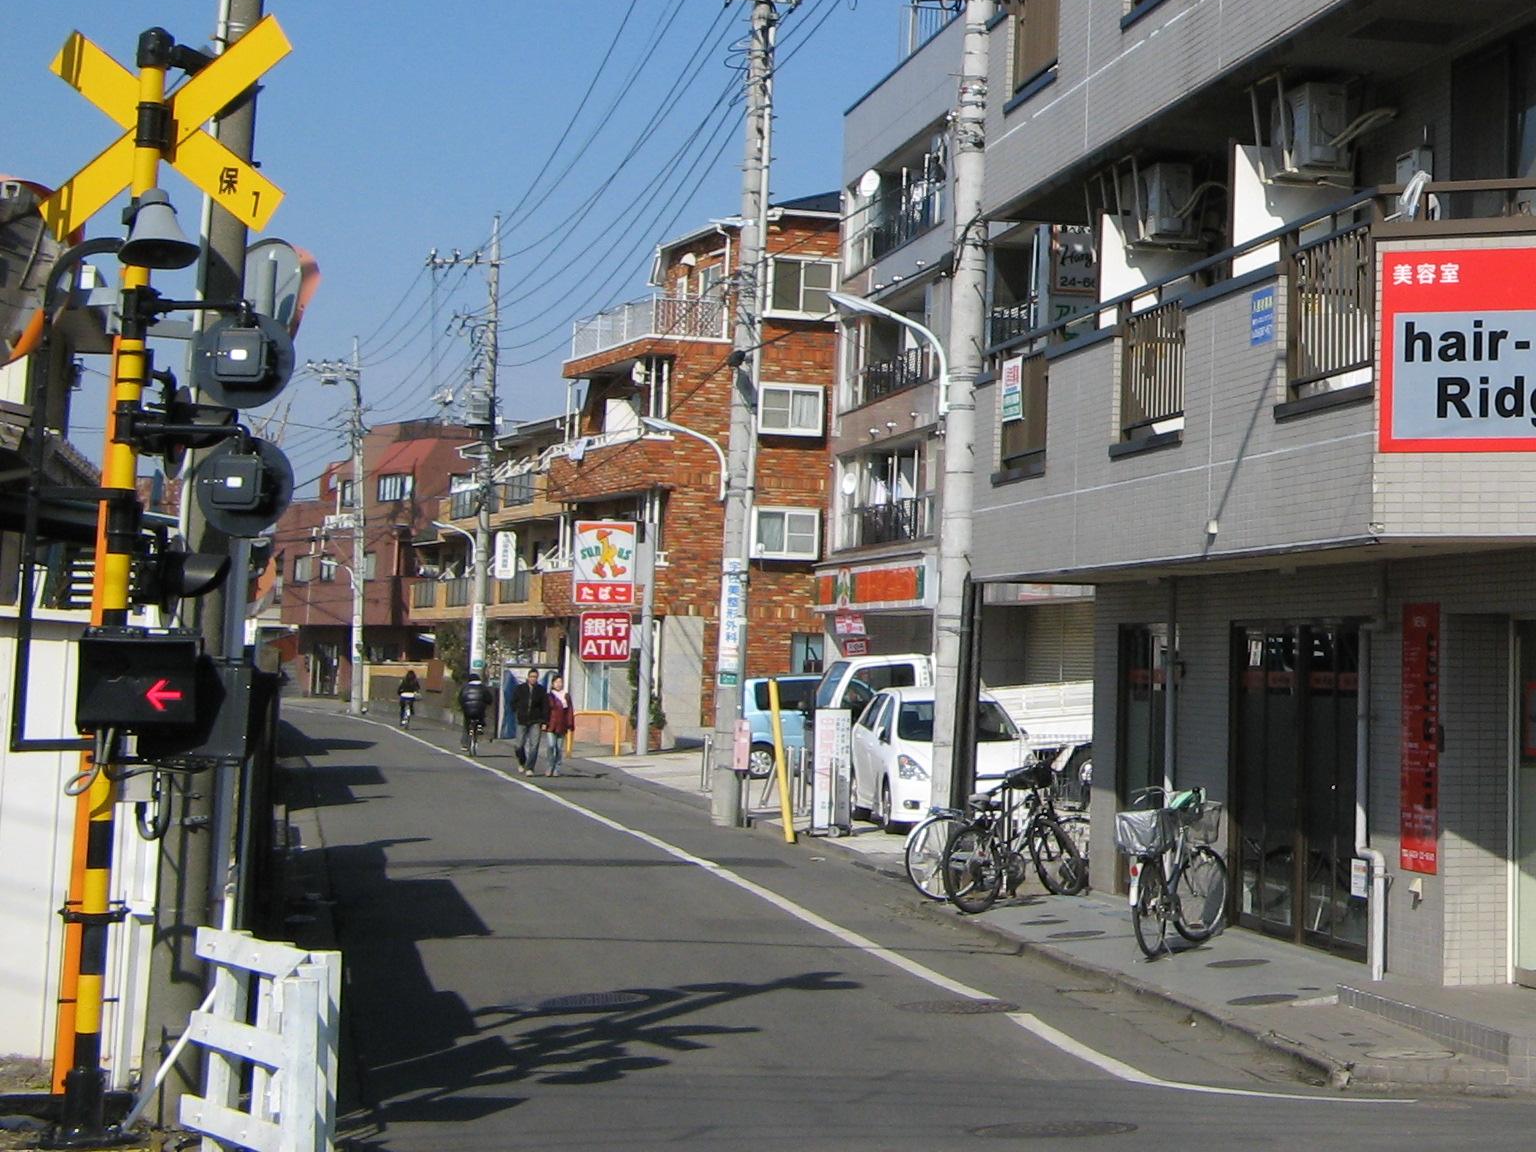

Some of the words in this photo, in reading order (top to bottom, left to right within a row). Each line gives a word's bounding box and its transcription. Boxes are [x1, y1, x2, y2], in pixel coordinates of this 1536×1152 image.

[219, 167, 239, 195] 保
[1393, 263, 1460, 286] 美容室
[1402, 322, 1531, 363] hair-
[580, 586, 627, 601] たばこ
[584, 618, 629, 638] 銀行
[583, 640, 628, 656] ATM
